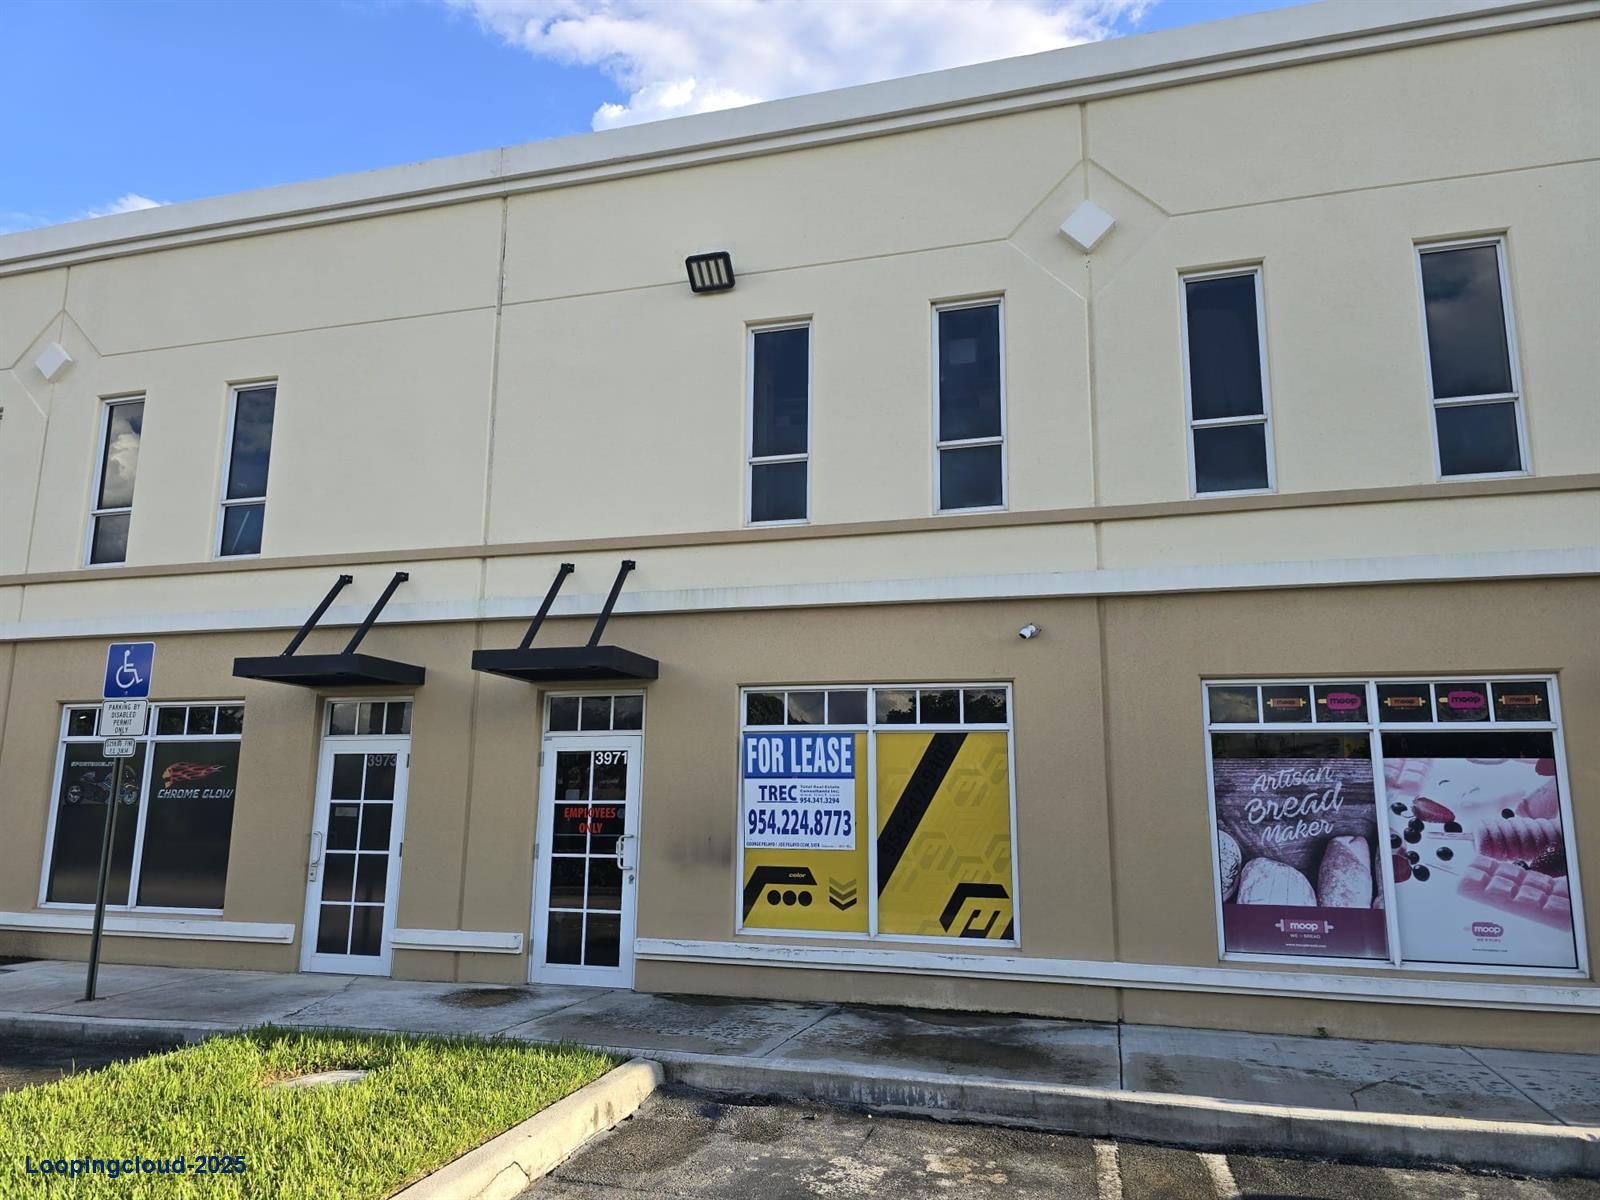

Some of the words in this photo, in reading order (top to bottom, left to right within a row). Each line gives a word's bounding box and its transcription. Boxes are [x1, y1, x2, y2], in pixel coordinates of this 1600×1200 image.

[1330, 697, 1356, 705] moop
[1451, 696, 1481, 704] moop
[108, 703, 132, 711] PARKING
[133, 703, 141, 711] BY
[111, 711, 137, 719] DISABLED
[112, 719, 133, 727] PERMIT
[114, 727, 129, 735] ONLY
[367, 754, 397, 767] 3973
[595, 751, 628, 765] 3971
[747, 737, 784, 774] FOR
[790, 737, 852, 774] LEASE
[1251, 766, 1334, 793] Artisan
[157, 789, 200, 799] CHROME
[202, 789, 234, 799] GLOW
[758, 785, 797, 801] TREC
[1244, 781, 1344, 825] Bread
[564, 807, 616, 819] EMPLOYEES
[578, 822, 603, 834] ONLY
[748, 809, 852, 836] 954.224.8773
[1261, 819, 1334, 845] Maker
[1290, 922, 1319, 932] moop
[1474, 926, 1501, 934] moop
